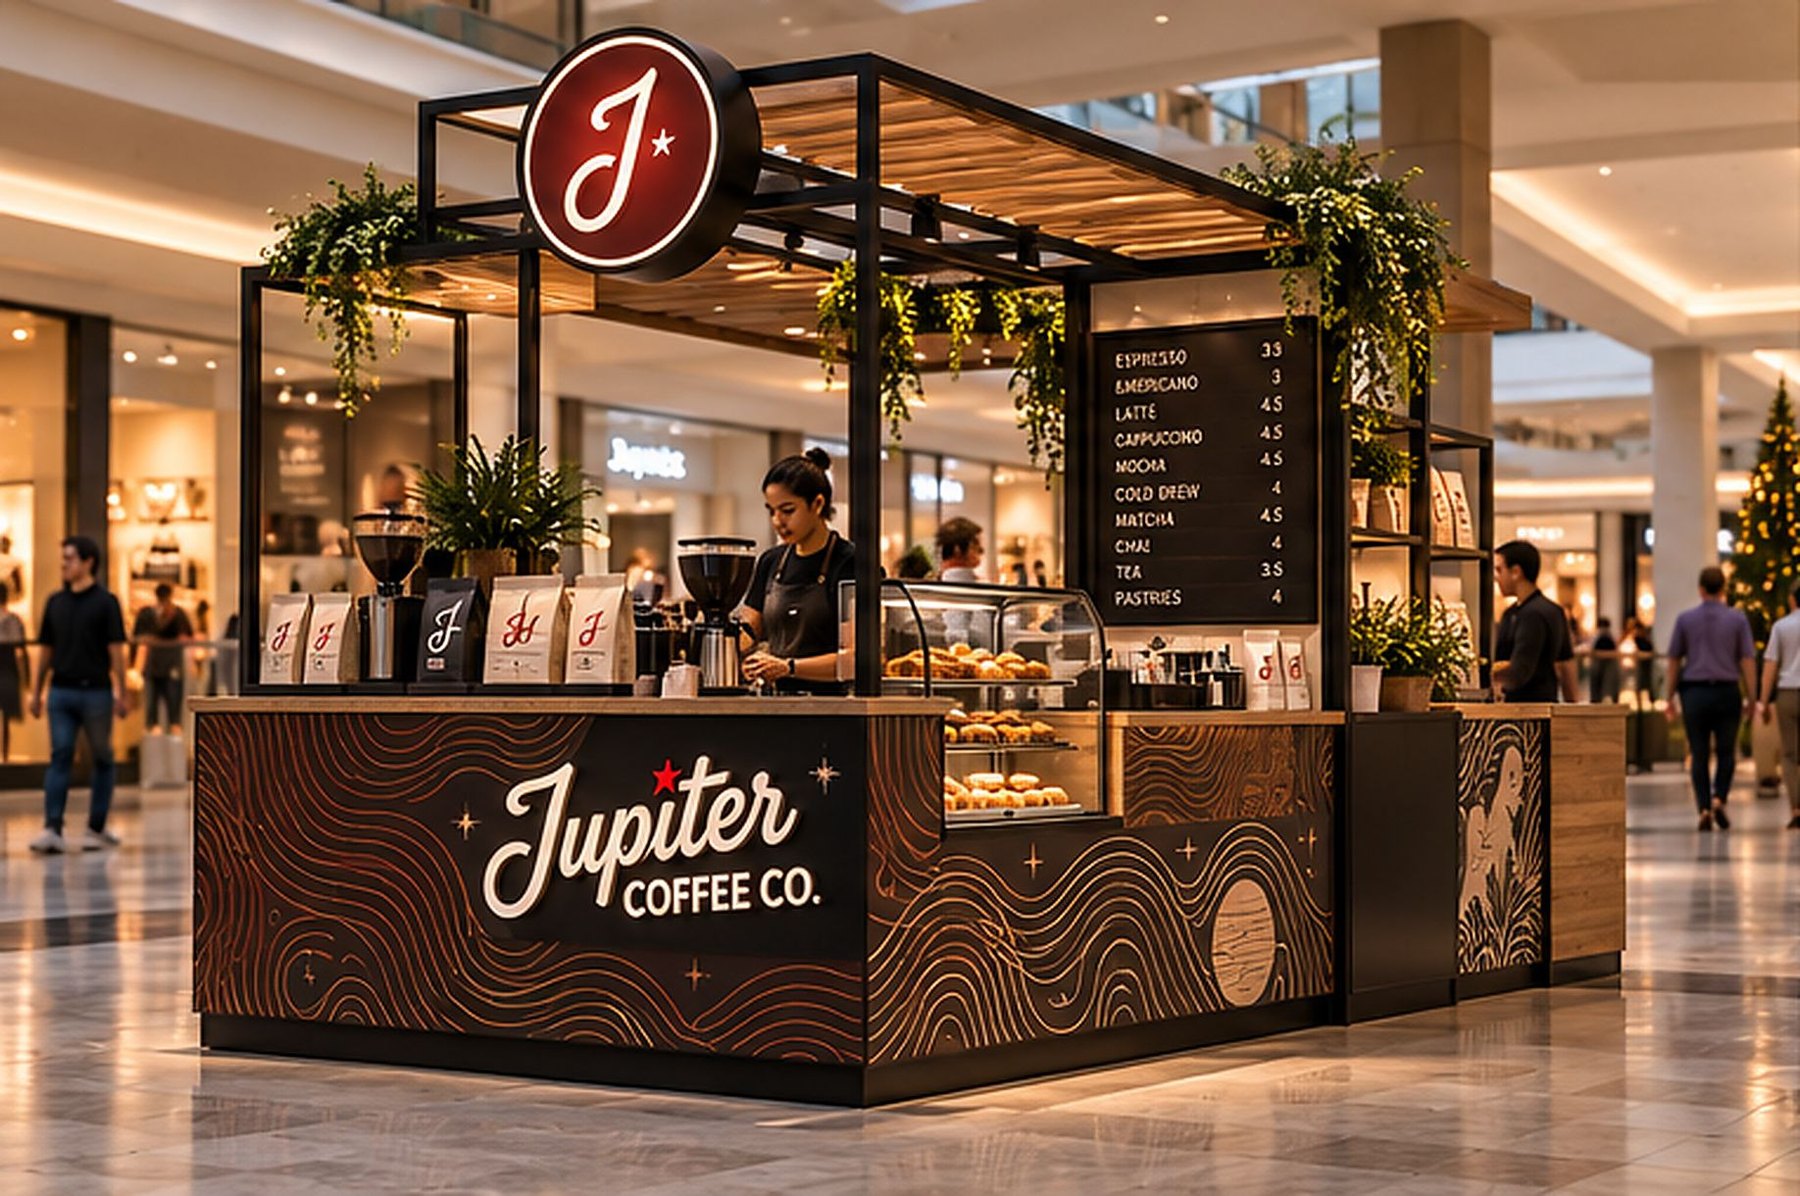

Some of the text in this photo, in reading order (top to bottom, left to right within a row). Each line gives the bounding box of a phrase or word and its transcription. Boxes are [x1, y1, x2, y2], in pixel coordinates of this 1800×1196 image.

[564, 67, 658, 233] J
[1271, 368, 1281, 385] 3
[483, 755, 798, 919] Jupiter
[622, 866, 822, 918] COFFEE CO.
